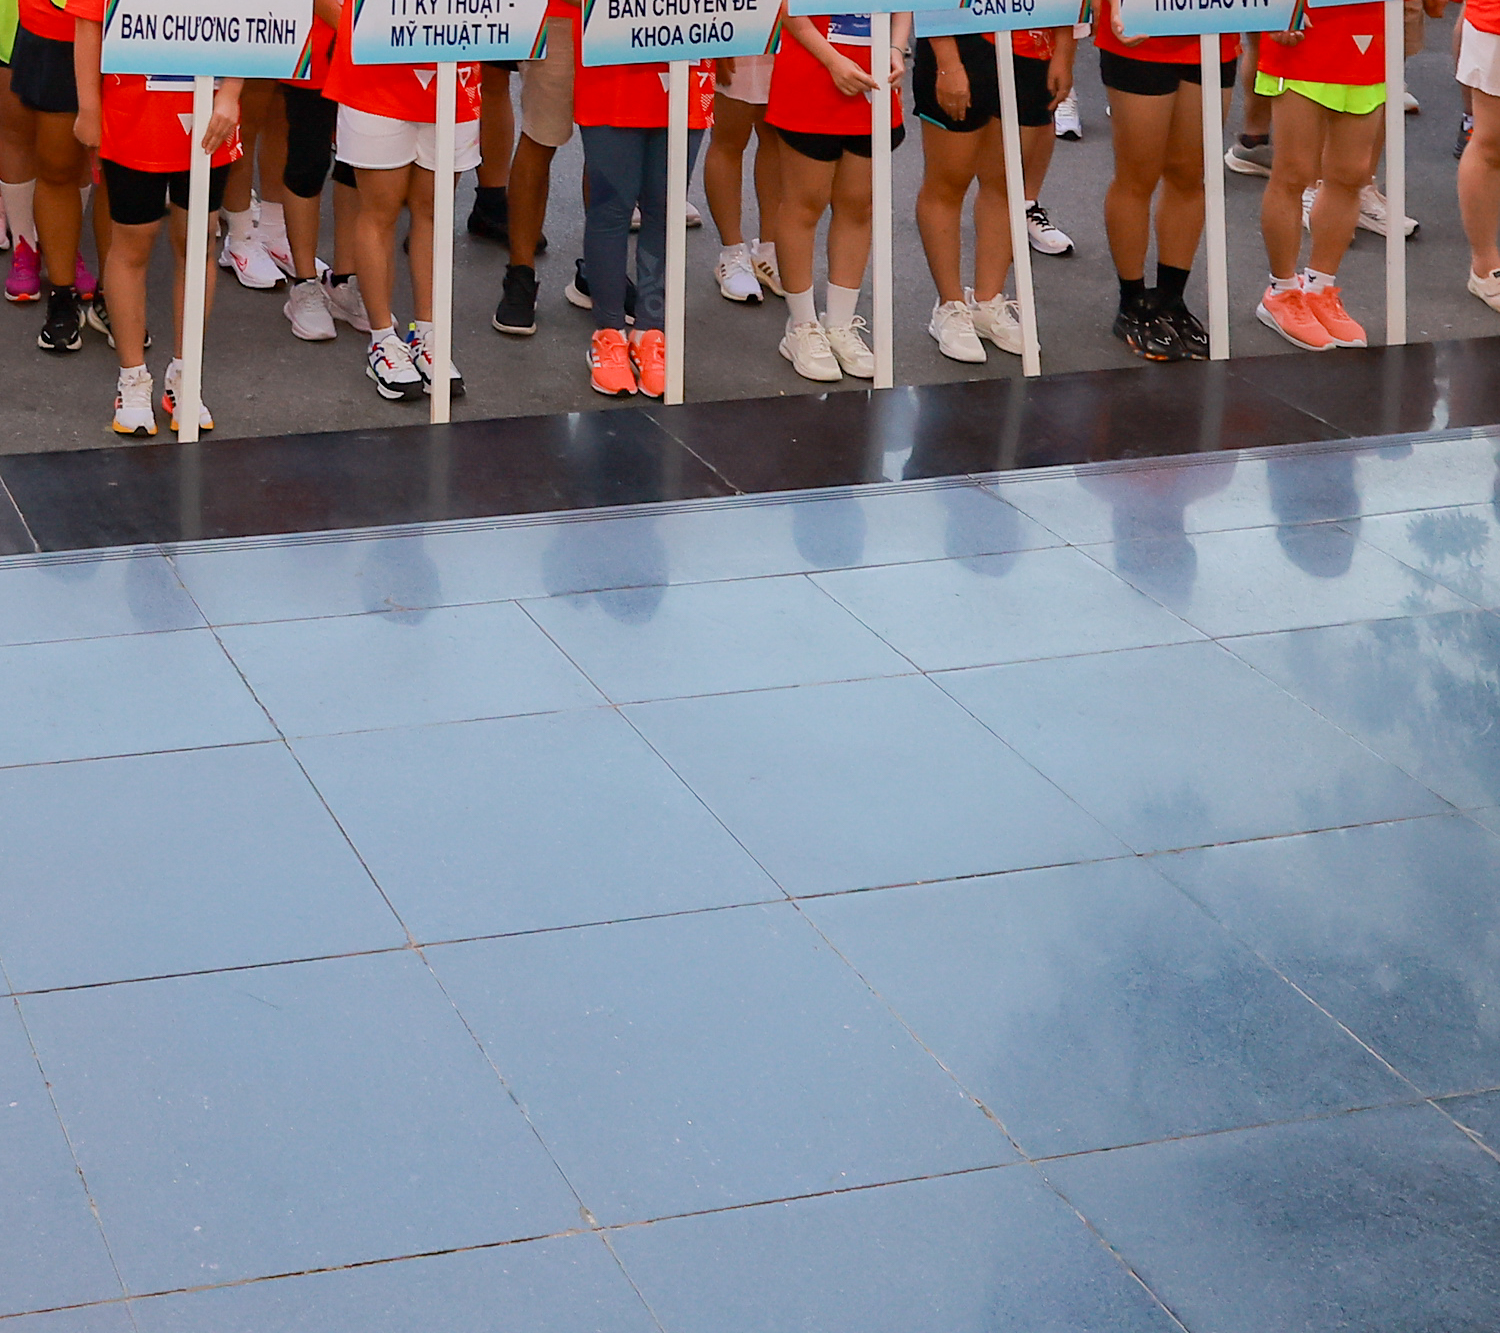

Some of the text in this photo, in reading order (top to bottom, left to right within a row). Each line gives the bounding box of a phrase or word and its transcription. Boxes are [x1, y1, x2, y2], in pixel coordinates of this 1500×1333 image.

[121, 12, 297, 44] BAN CHƯƠNG TRÌNH
[391, 20, 509, 50] MỸ THUẬT TH
[631, 17, 734, 48] KHOA GIÁO
